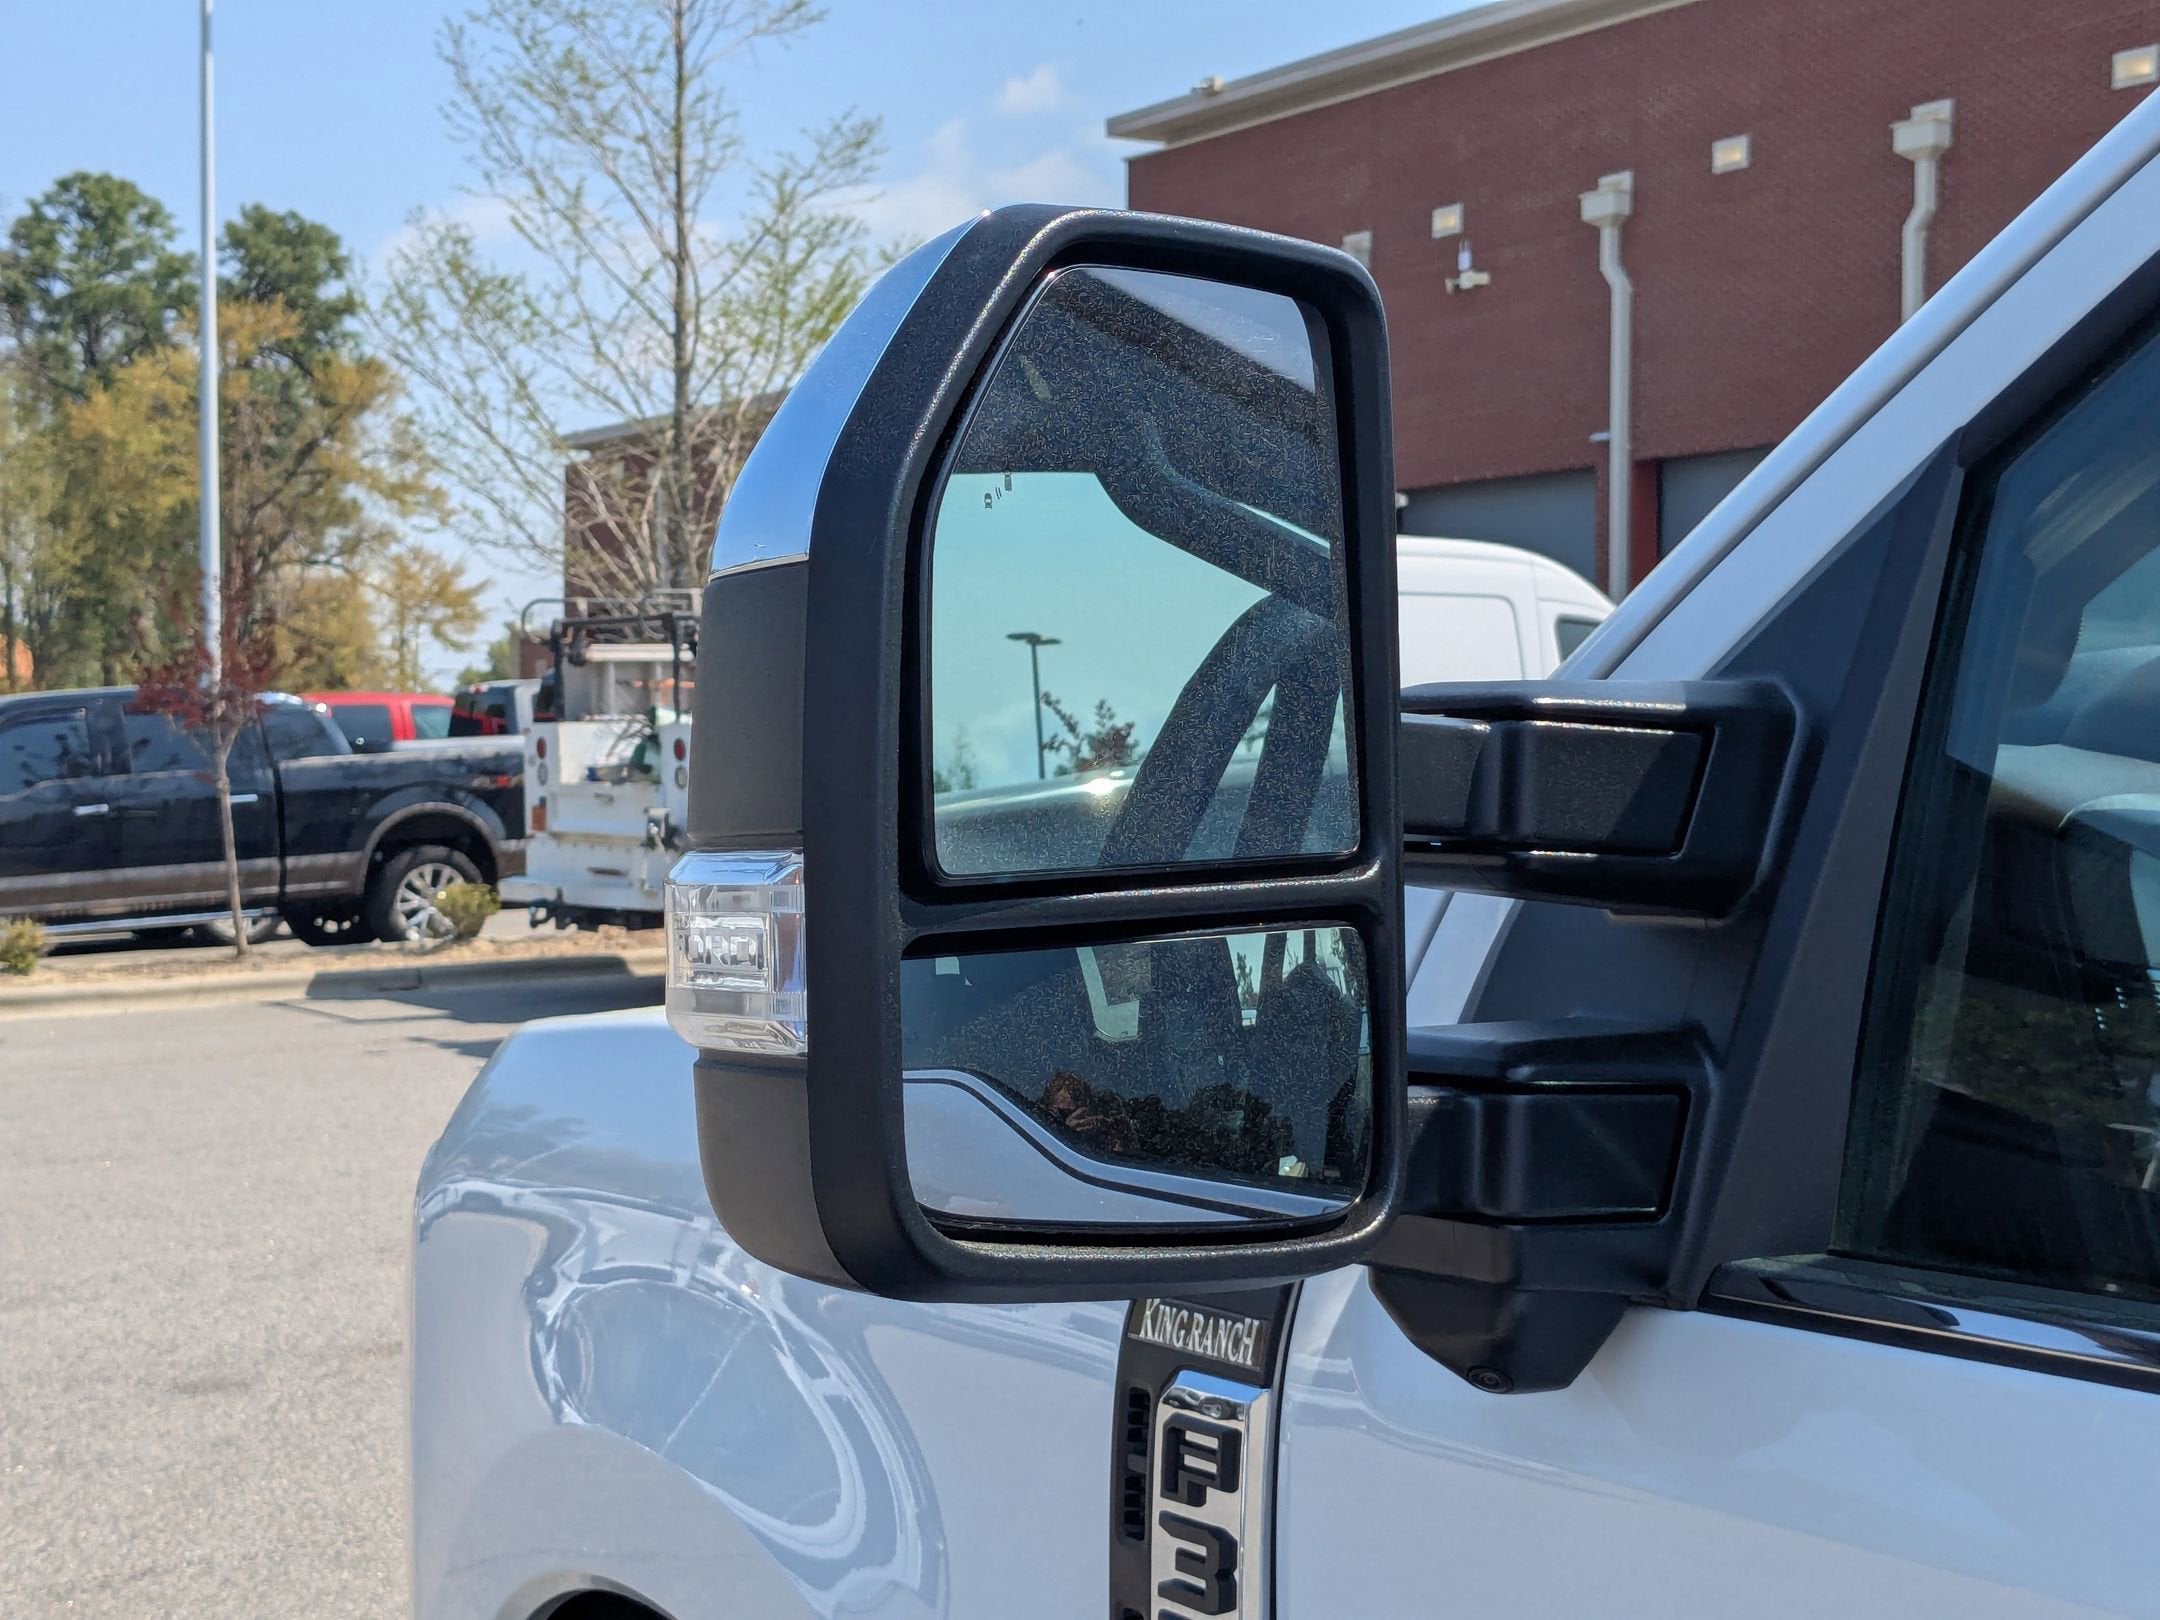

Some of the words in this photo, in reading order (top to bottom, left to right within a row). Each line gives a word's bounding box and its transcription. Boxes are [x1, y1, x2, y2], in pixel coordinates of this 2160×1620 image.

[1138, 1298, 1189, 1348] KING
[1186, 1311, 1260, 1366] RANCH
[1157, 1411, 1243, 1620] F3
